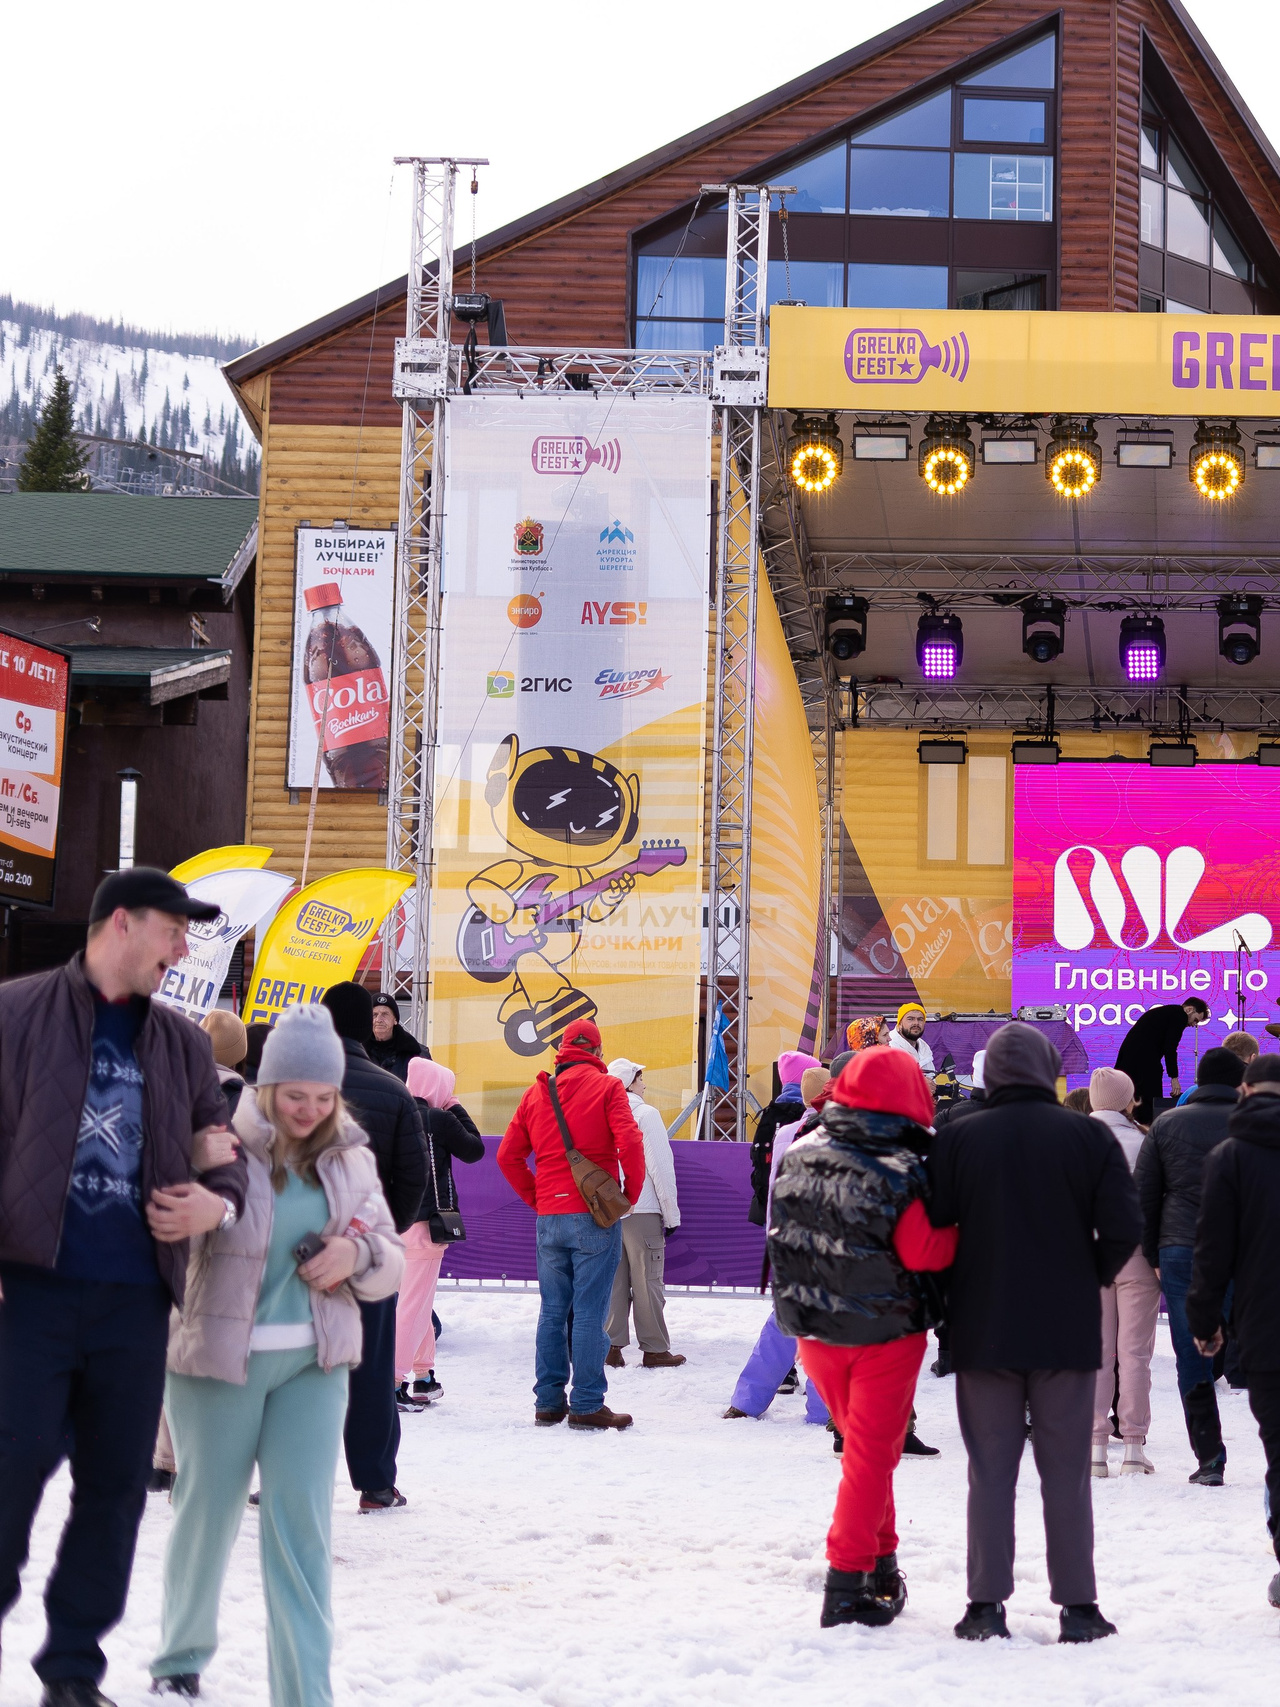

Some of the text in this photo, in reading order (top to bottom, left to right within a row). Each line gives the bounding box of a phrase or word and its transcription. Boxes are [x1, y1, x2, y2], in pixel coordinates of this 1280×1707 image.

[857, 336, 916, 354] GRELKA
[857, 357, 897, 376] FEST
[541, 441, 583, 455] GRELKA
[540, 456, 569, 469] FEST
[314, 537, 386, 550] ВЫБИРАЙ
[596, 549, 637, 557] ДИРЕКЦИЯ
[322, 566, 375, 576] БОЧКАРИ
[599, 564, 634, 572] ШЕРЕГЕШ
[511, 607, 540, 617] энгиро
[581, 601, 648, 625] AYS!
[13, 655, 26, 674] 10
[28, 661, 56, 684] ЛЕТ!
[521, 677, 573, 692] 2ГИС
[313, 677, 384, 715] Cola
[327, 707, 378, 735] Bochkari
[8, 745, 38, 762] концерт
[17, 808, 49, 824] вечером
[16, 872, 32, 886] 2:00
[308, 904, 347, 927] GRELKA
[303, 917, 330, 934] FEST
[289, 936, 305, 945] SUN
[313, 939, 332, 950] RIDE
[870, 896, 943, 974] Cola
[282, 946, 343, 964] MUSIC FESTIVAL
[1054, 962, 1268, 992] Главные по
[254, 977, 326, 1009] GRELK
